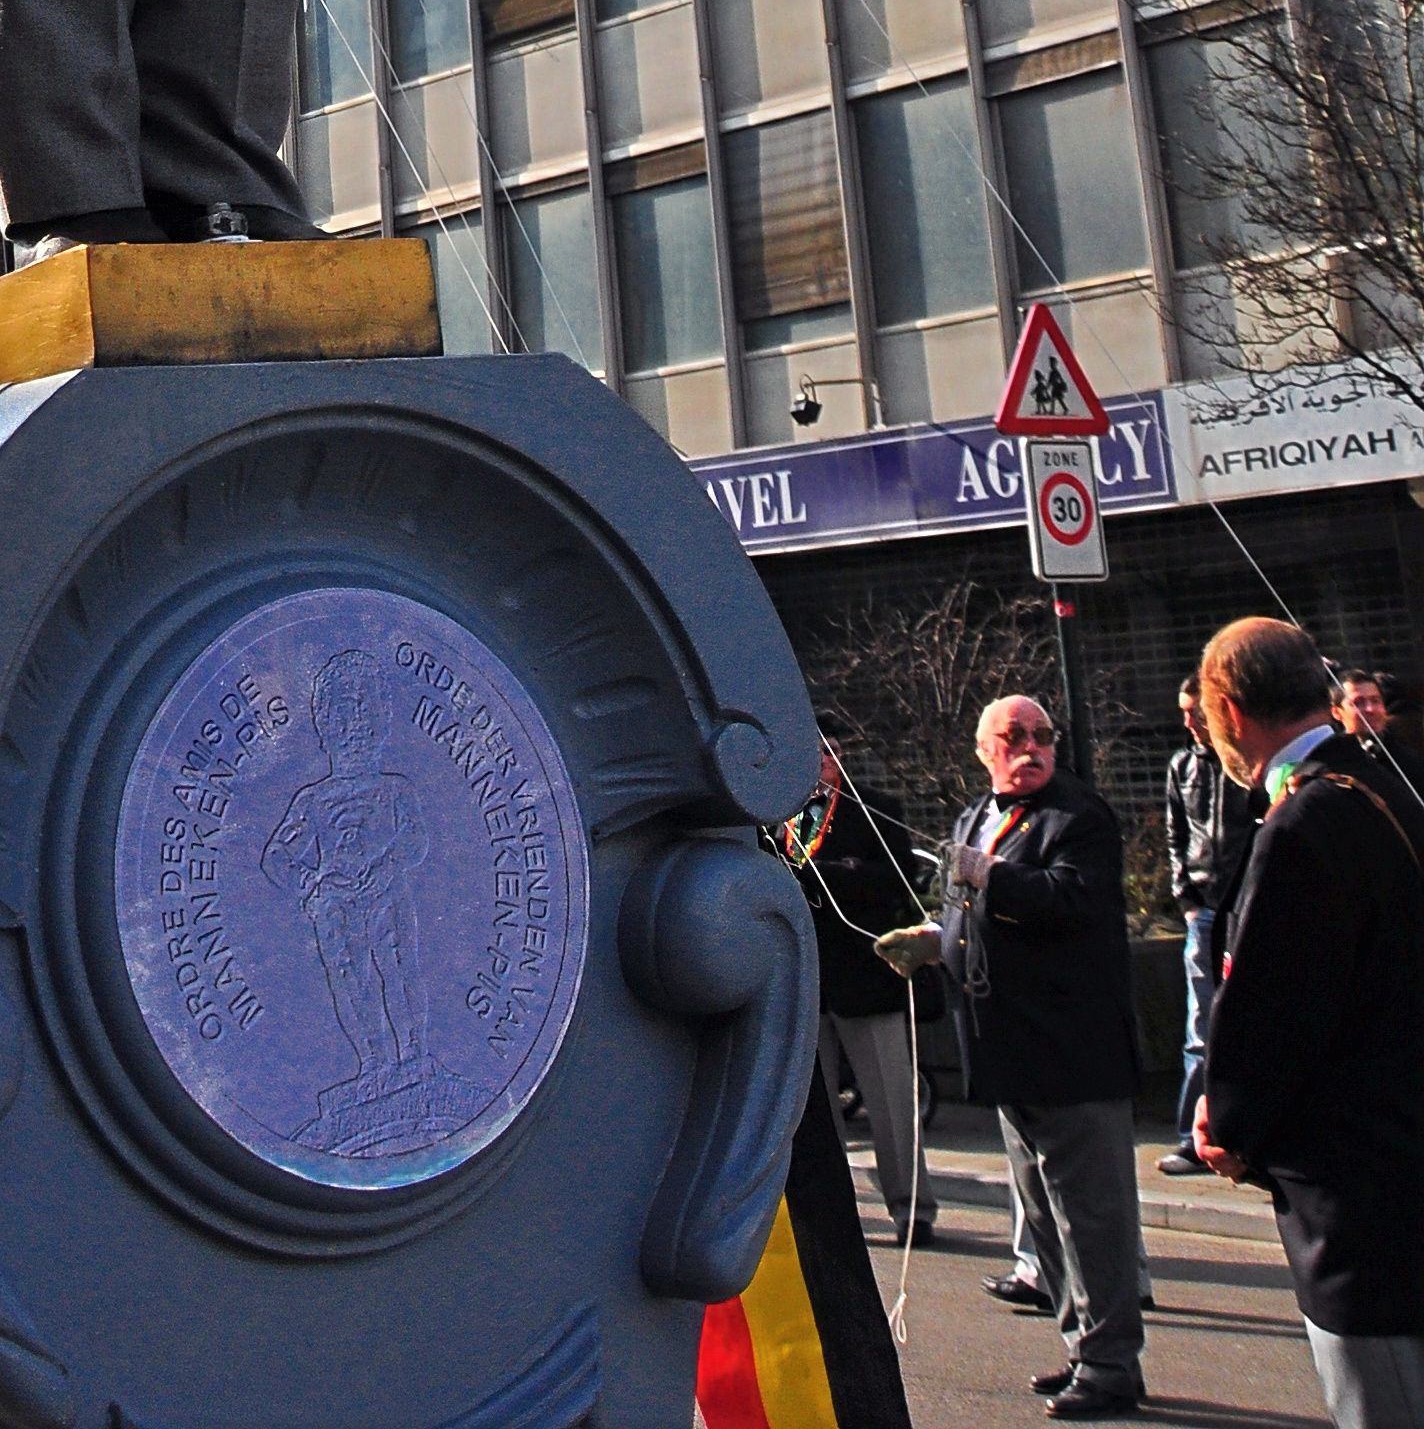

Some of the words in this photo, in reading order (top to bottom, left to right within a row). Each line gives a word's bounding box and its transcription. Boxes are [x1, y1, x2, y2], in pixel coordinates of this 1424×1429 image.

[956, 419, 1151, 503] AGCY
[1043, 451, 1080, 468] ZONE
[1198, 428, 1396, 478] AFRIQIYAH
[1052, 496, 1082, 523] 30
[219, 672, 264, 728] DE
[394, 641, 475, 711] ORDE
[172, 718, 224, 812] AMIS
[469, 705, 520, 779] DER
[160, 816, 188, 896] DES
[188, 695, 290, 1032] MANNEKEN-PIS
[412, 694, 524, 1020] MANNEKEN-PIS
[509, 777, 552, 977] VRIENDEN
[161, 907, 225, 1041] ORDRE
[487, 985, 536, 1061] VAN
